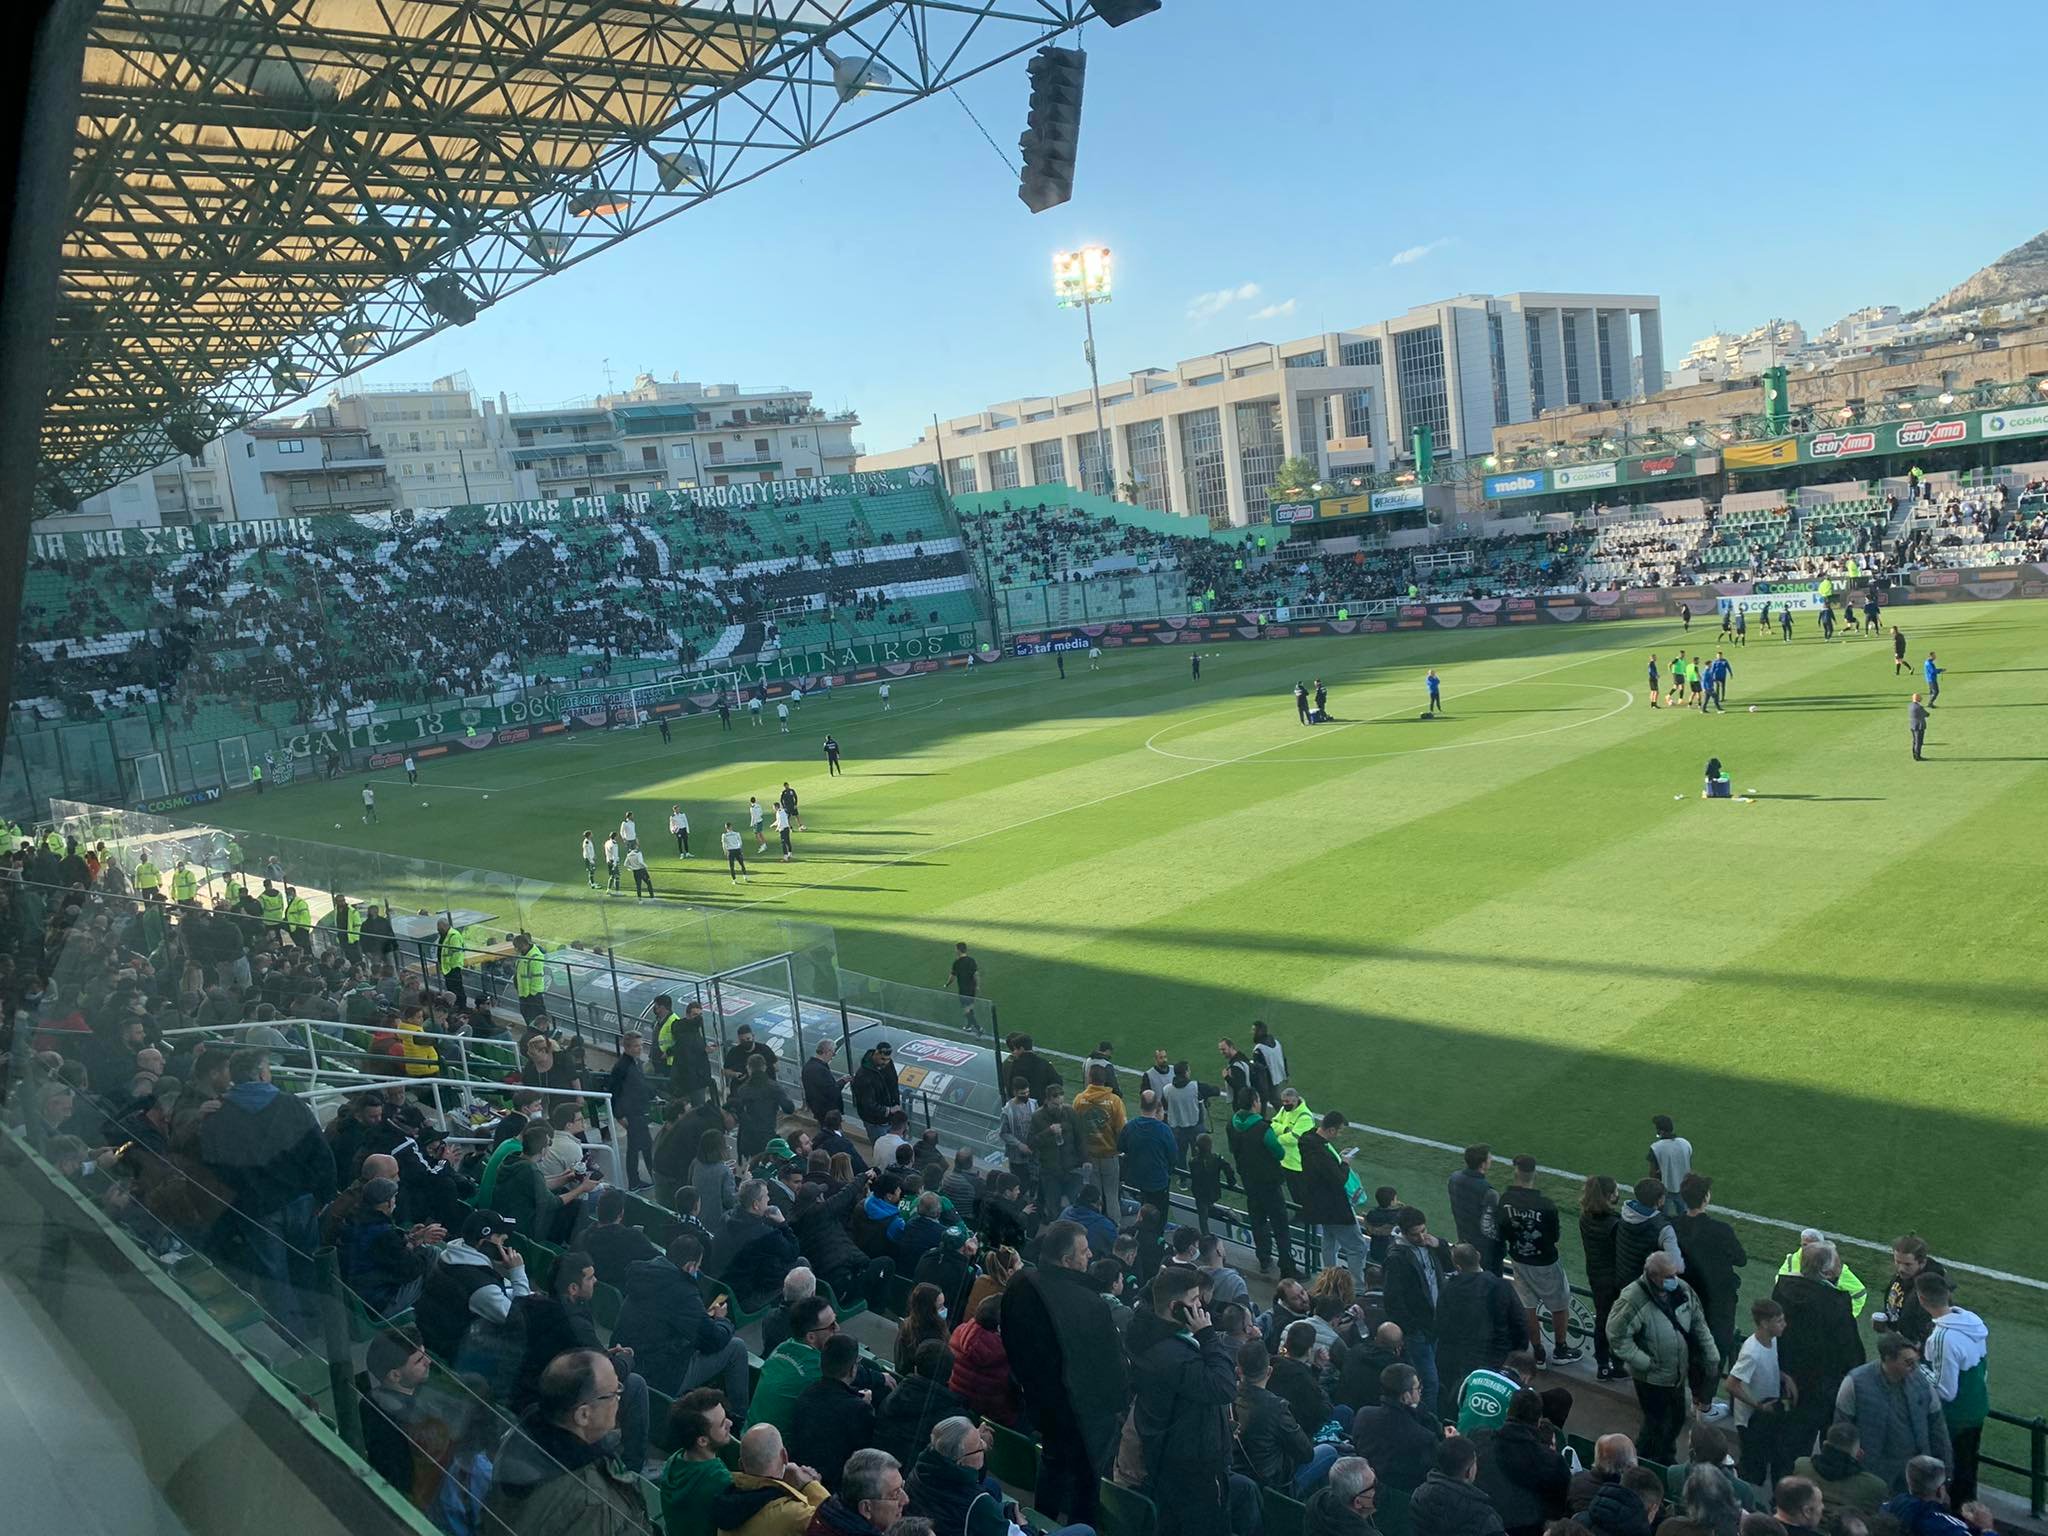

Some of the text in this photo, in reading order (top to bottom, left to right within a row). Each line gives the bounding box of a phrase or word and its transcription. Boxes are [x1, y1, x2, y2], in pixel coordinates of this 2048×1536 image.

[1034, 642, 1052, 654] taf
[1054, 638, 1089, 652] media
[414, 712, 444, 738] 13
[206, 787, 220, 800] TV
[1470, 1395, 1498, 1414] OTE
